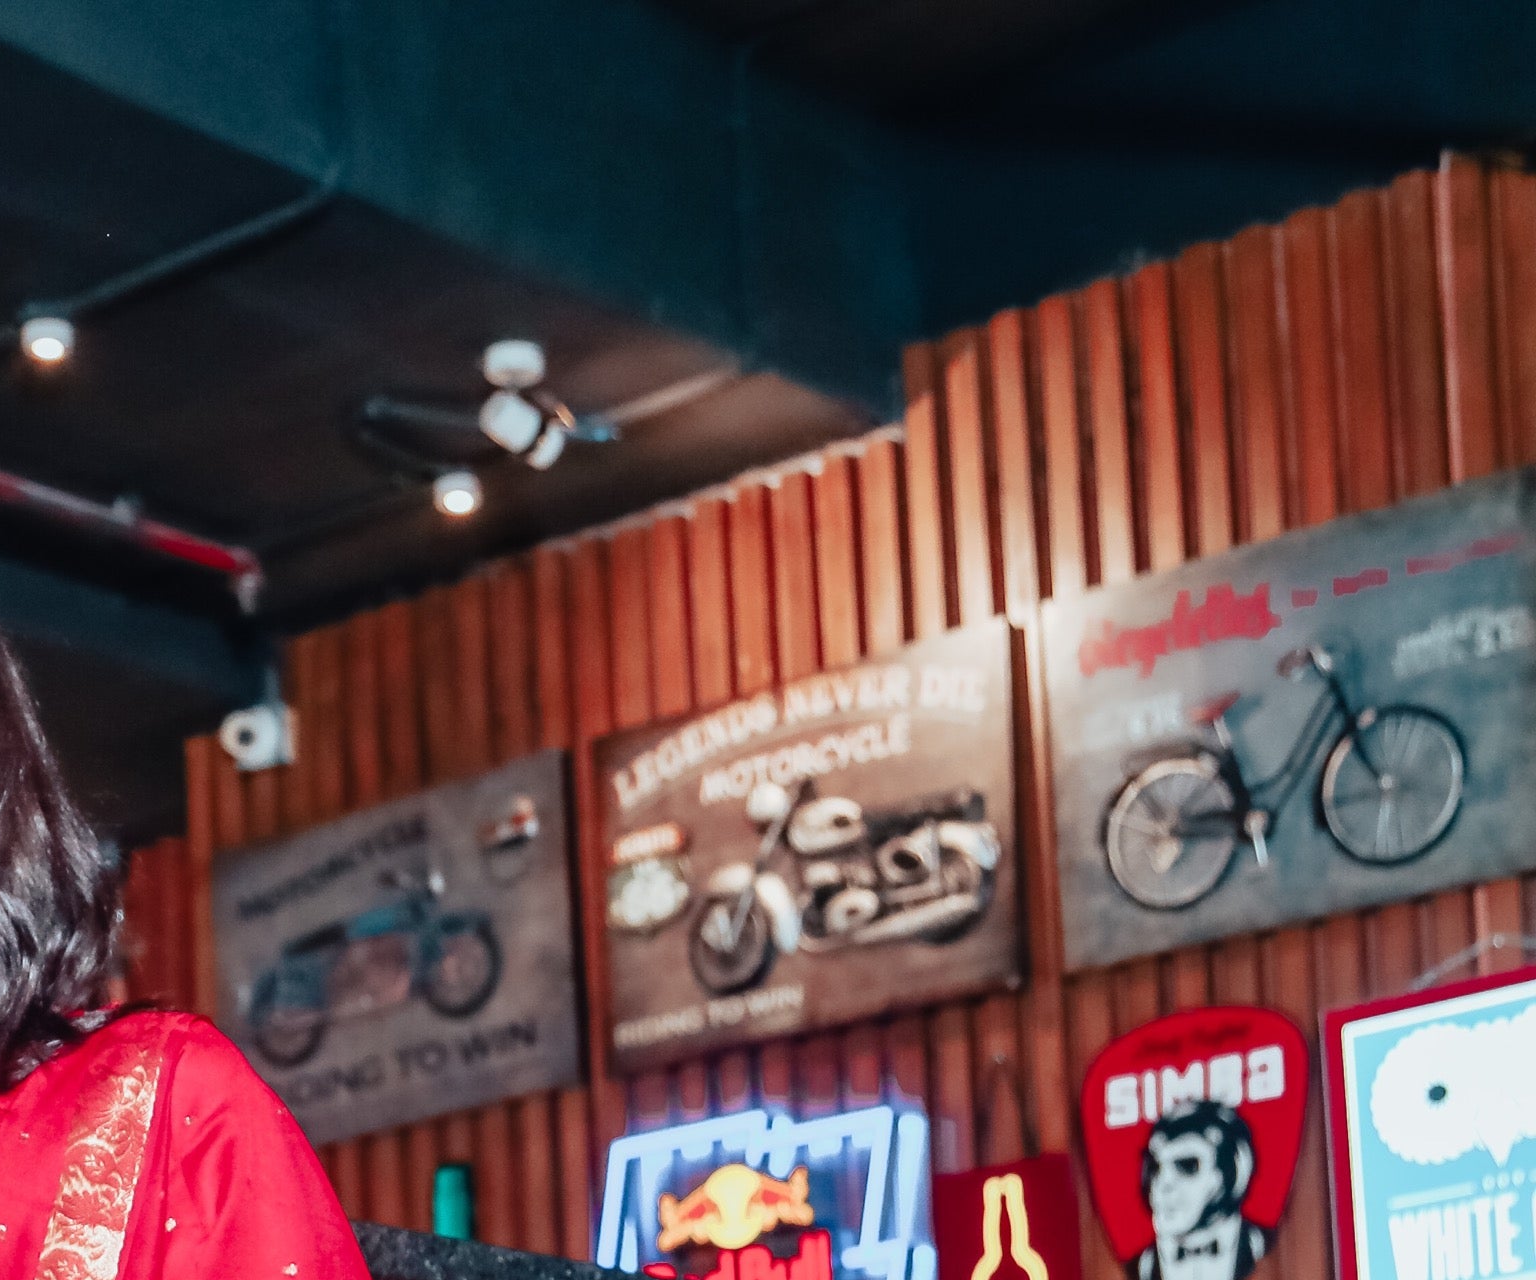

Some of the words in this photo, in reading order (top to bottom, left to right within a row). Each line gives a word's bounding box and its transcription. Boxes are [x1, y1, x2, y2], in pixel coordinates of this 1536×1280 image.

[700, 711, 912, 803] MOTORCYCLE
[396, 1040, 449, 1079] TO
[459, 1019, 539, 1064] WIN
